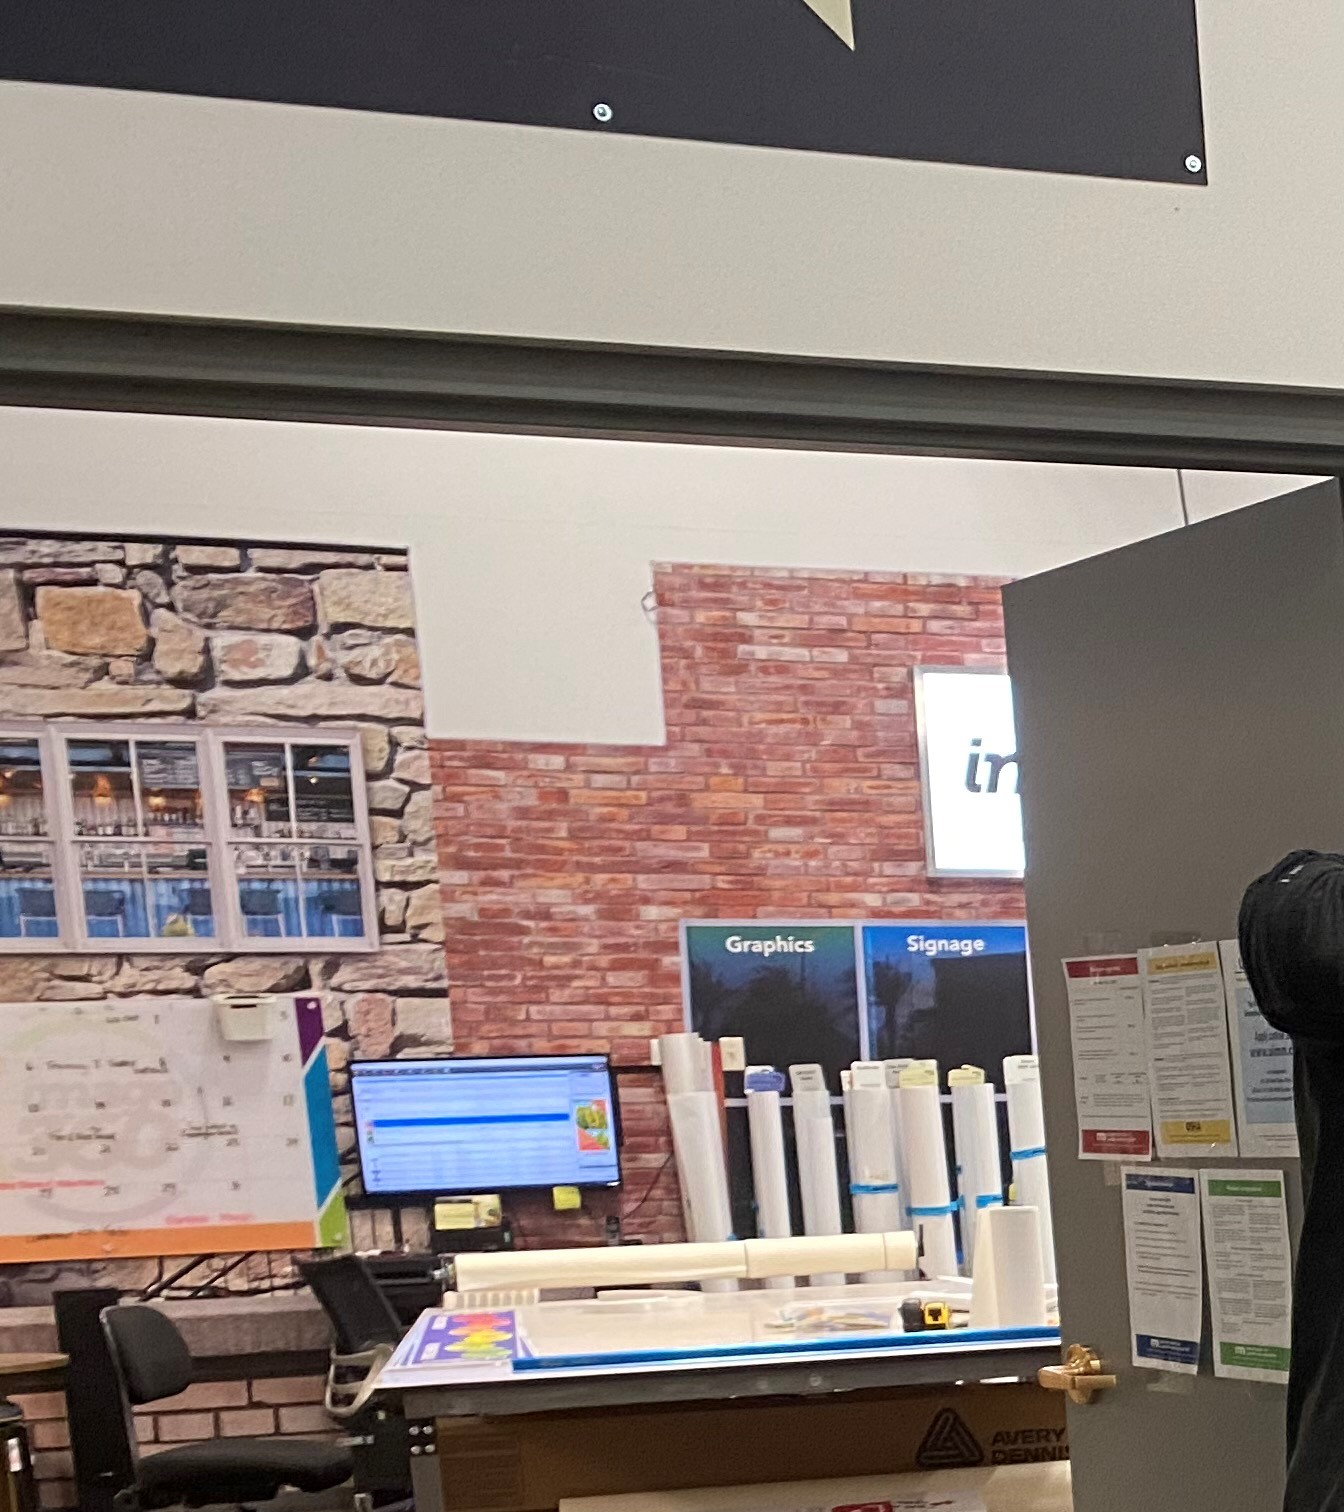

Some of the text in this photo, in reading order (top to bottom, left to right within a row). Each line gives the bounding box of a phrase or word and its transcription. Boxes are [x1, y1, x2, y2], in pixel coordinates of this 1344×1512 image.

[725, 933, 816, 958] Graphics
[906, 934, 986, 957] Signage
[991, 1426, 1067, 1447] AVERY
